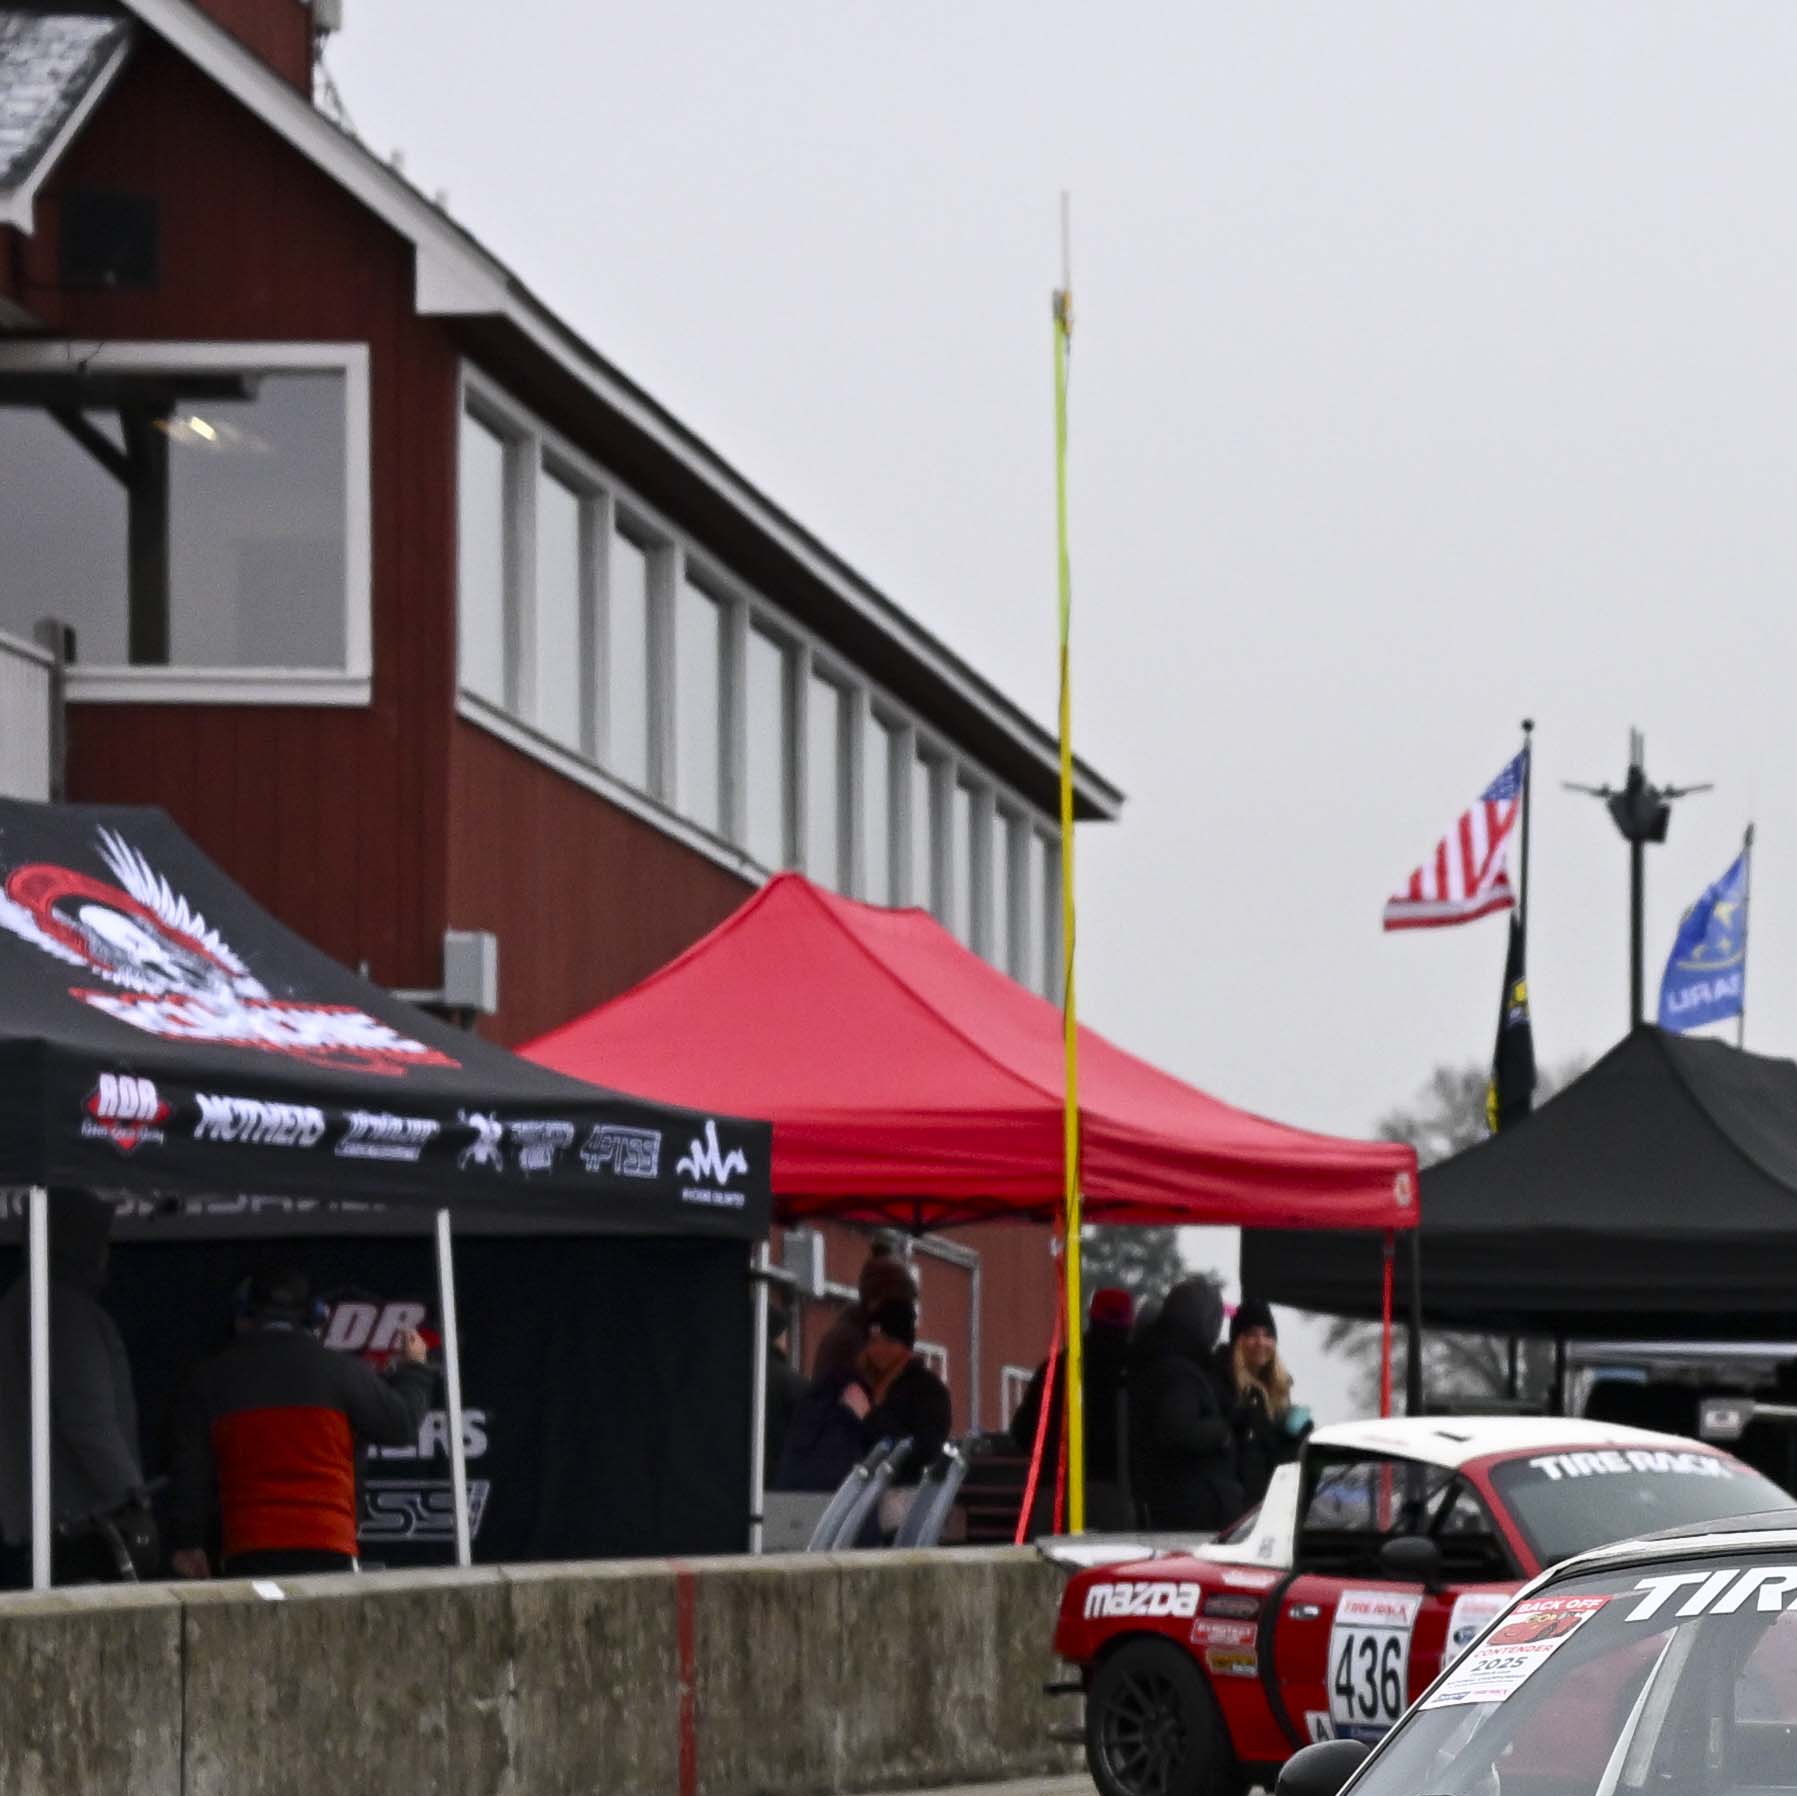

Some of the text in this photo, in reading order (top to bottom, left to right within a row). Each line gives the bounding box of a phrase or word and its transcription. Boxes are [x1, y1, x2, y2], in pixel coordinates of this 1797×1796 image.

[1529, 1450, 1733, 1480] TIRE RACK
[1518, 1599, 1603, 1613] BACK OFF
[1474, 1645, 1554, 1658] CONTENDER
[1471, 1656, 1528, 1672] 2025
[1335, 1634, 1402, 1720] 436
